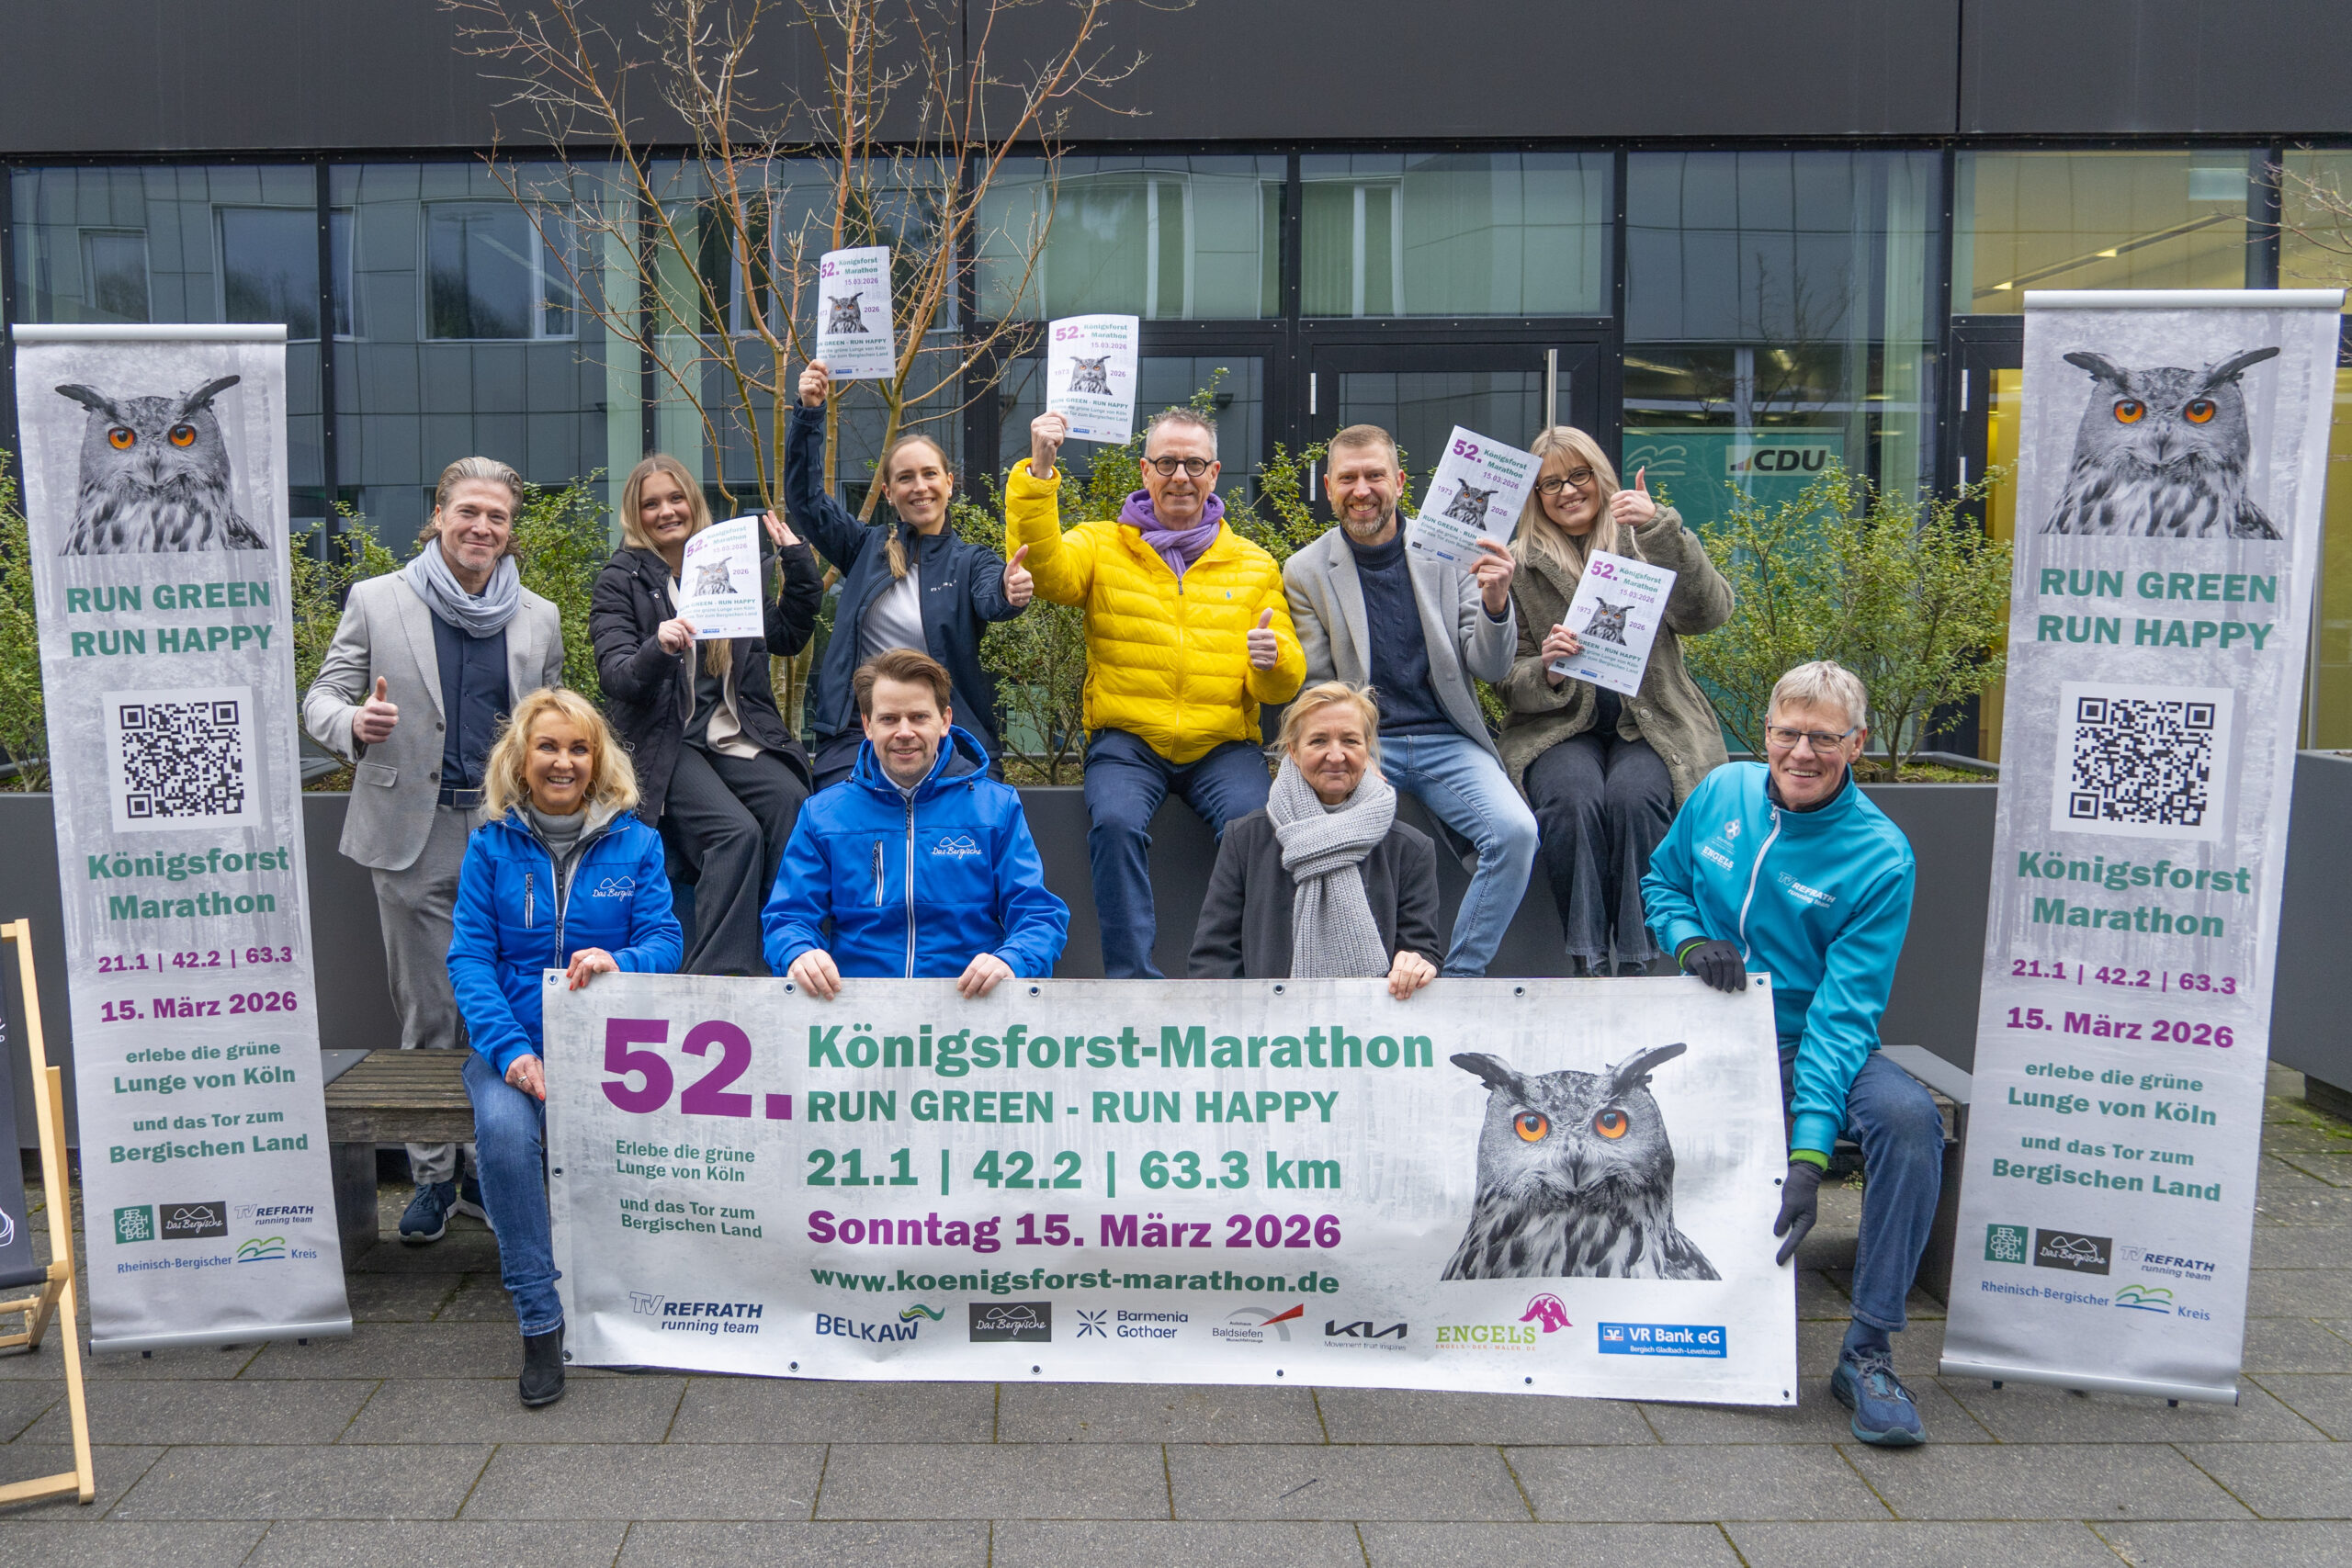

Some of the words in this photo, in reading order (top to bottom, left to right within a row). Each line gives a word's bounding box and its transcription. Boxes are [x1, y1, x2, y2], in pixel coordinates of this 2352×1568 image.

[821, 262, 839, 278] 52.
[1453, 439, 1482, 463] 52.
[1754, 449, 1826, 471] CDU
[1484, 472, 1519, 489] 15.03.2026
[1487, 461, 1522, 481] Marathon
[1439, 486, 1453, 495] 1973
[1491, 506, 1507, 516] 2026
[1423, 514, 1437, 525] RUN
[1436, 521, 1459, 534] GREEN
[1591, 561, 1617, 581] 52.
[1621, 589, 1654, 604] 15.03.2026
[1623, 579, 1657, 595] Marathon
[2040, 569, 2123, 597] RUN
[2137, 571, 2277, 603] GREEN
[66, 586, 141, 613] RUN
[153, 581, 270, 610] GREEN
[1577, 606, 1590, 615] 1973
[1629, 622, 1645, 630] 2026
[2038, 615, 2120, 644] RUN
[2135, 619, 2273, 650] HAPPY
[72, 629, 145, 657] RUN
[157, 625, 272, 653] HAPPY
[1620, 651, 1641, 661] HAPPY
[88, 846, 288, 882] Königsforst
[2018, 852, 2250, 894] Königsforst
[109, 892, 276, 920] Marathon
[2033, 897, 2223, 937] Marathon
[98, 953, 149, 973] 21.1
[173, 951, 220, 968] 42.2
[246, 946, 292, 964] 63.3
[2012, 959, 2066, 979] 21.1
[2095, 966, 2150, 987] 42.2
[2179, 973, 2235, 995] 63.3
[102, 1000, 144, 1022] 15.
[153, 997, 220, 1018] März
[229, 991, 297, 1014] 2026
[2007, 1007, 2052, 1031] 15.
[2064, 1011, 2142, 1040] März
[2151, 1020, 2233, 1048] 2026
[126, 1048, 186, 1063] erlebe
[191, 1045, 220, 1060] die
[227, 1042, 280, 1060] grüne
[808, 1023, 1433, 1077] Königsforst-Marathon
[601, 1018, 792, 1120] 52.
[2025, 1063, 2094, 1081] erlebe
[2100, 1070, 2134, 1086] die
[2139, 1074, 2203, 1091] grüne
[114, 1075, 187, 1094] Lunge
[193, 1074, 235, 1089] von
[243, 1066, 295, 1085] Köln
[808, 1090, 896, 1122] RUN
[910, 1089, 1053, 1122] GREEN
[1092, 1091, 1180, 1122] RUN
[1196, 1091, 1339, 1122] HAPPY
[2008, 1087, 2089, 1114] Lunge
[2098, 1100, 2145, 1118] von
[2154, 1101, 2216, 1125] Köln
[133, 1117, 167, 1132] und
[174, 1116, 207, 1129] das
[211, 1114, 240, 1127] Tor
[246, 1111, 283, 1123] zum
[110, 1140, 244, 1163] Bergischen
[253, 1134, 308, 1152] Land
[616, 1140, 668, 1157] Erlebe
[674, 1145, 699, 1159] die
[706, 1146, 754, 1164] grüne
[2021, 1137, 2060, 1151] und
[2066, 1139, 2106, 1156] das
[2112, 1144, 2144, 1160] Tor
[2149, 1150, 2193, 1166] zum
[616, 1159, 665, 1179] Lunge
[672, 1168, 700, 1179] von
[707, 1166, 744, 1181] Köln
[808, 1148, 918, 1186] 21.1
[973, 1150, 1081, 1189] 42.2
[1140, 1150, 1250, 1189] 63.3
[1267, 1151, 1340, 1189] km
[1993, 1158, 2143, 1190] Bergischen
[2153, 1175, 2221, 1201] Land
[256, 1206, 313, 1216] REFRATH
[620, 1199, 649, 1212] und
[655, 1200, 684, 1213] das
[689, 1201, 715, 1216] Tor
[720, 1208, 754, 1220] zum
[166, 1220, 180, 1230] Das
[182, 1219, 223, 1234] Bergische
[255, 1217, 289, 1225] running
[622, 1213, 716, 1234] Bergischen
[721, 1223, 762, 1238] Land
[808, 1211, 1001, 1253] Sonntag
[1016, 1213, 1083, 1247] 15.
[1101, 1213, 1211, 1247] März
[1226, 1214, 1340, 1248] 2026
[118, 1256, 232, 1273] Rheinisch-Bergischer
[291, 1249, 317, 1258] Kreis
[2040, 1247, 2058, 1258] Das
[2058, 1249, 2107, 1268] Bergische
[2144, 1253, 2215, 1272] REFRATH
[810, 1269, 1339, 1294] www.koenigsforst-marathon.de
[2142, 1265, 2182, 1278] running
[2186, 1271, 2211, 1280] team
[663, 1303, 763, 1318] REFRATH
[1982, 1280, 2109, 1305] Rheinisch-Bergischer
[2177, 1305, 2210, 1321] Kreis
[1117, 1310, 1188, 1322] Barmenia
[662, 1319, 718, 1335] running
[724, 1322, 759, 1334] team
[816, 1314, 918, 1343] BELKAW
[976, 1320, 995, 1330] Das
[996, 1319, 1046, 1336] Bergische
[1117, 1325, 1177, 1338] Gothaer
[1213, 1327, 1263, 1338] Baldsiefen
[1325, 1320, 1408, 1339] KIA
[1436, 1325, 1536, 1343] ENGELS
[1629, 1327, 1651, 1342] VR
[1656, 1328, 1694, 1343] Bank
[1698, 1330, 1720, 1344] eG
[1324, 1340, 1362, 1348] Movement
[1630, 1346, 1655, 1354] Bergisch
[1657, 1347, 1721, 1355] Gladbach-Leverkusen
